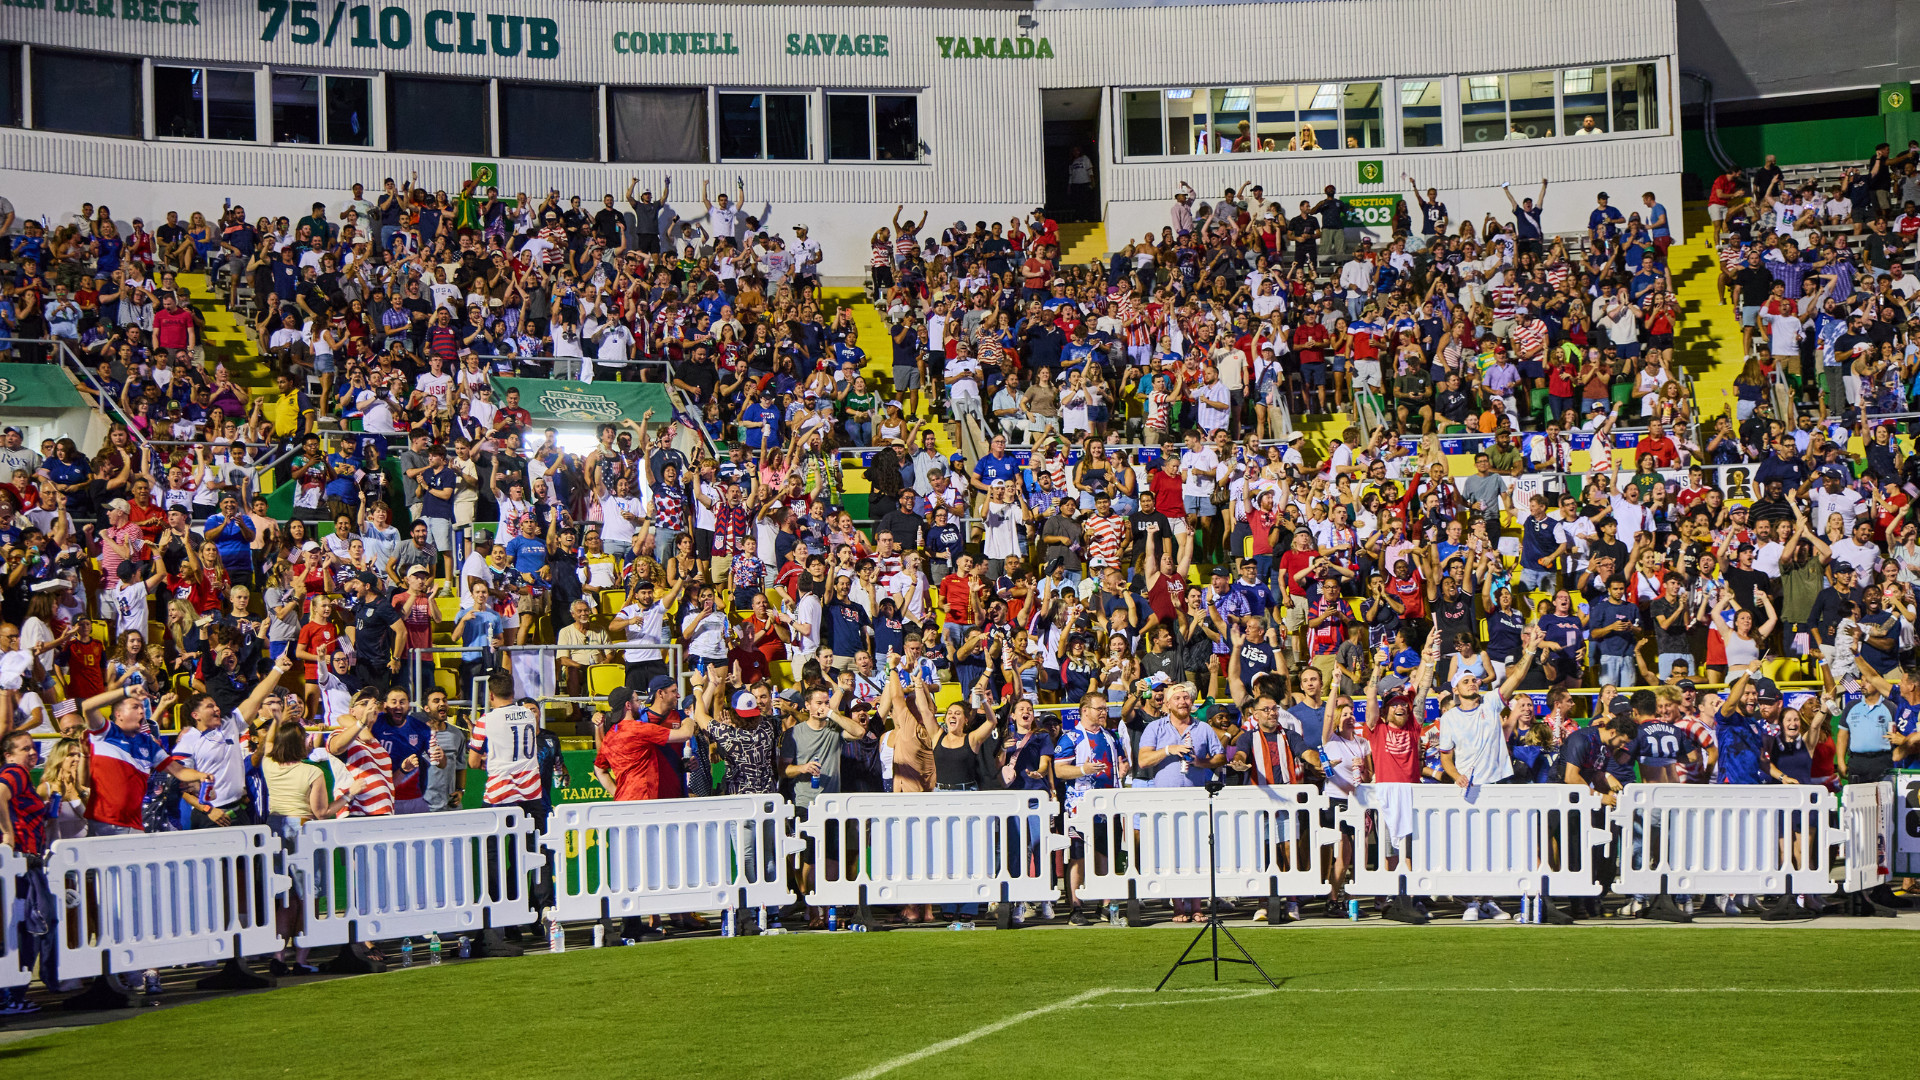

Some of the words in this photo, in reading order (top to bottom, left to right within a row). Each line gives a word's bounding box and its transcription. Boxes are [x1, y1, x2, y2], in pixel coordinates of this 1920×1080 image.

[121, 0, 200, 26] BECK
[258, 1, 411, 50] 75/10
[424, 10, 560, 60] CLUB
[613, 31, 739, 56] CONNELL
[786, 34, 889, 58] SAVAGE
[936, 36, 1054, 60] YAMADA
[1349, 198, 1393, 207] SECTION
[1354, 207, 1391, 223] 303
[430, 386, 446, 395] USA
[549, 392, 581, 400] TAMPA
[1, 452, 28, 468] RAYS
[988, 468, 996, 478] 10
[1517, 480, 1537, 491] USA
[1676, 474, 1690, 487] US
[940, 532, 958, 543] USA
[83, 654, 95, 666] 19
[505, 711, 528, 721] PULISIC
[1644, 723, 1675, 735] DONOVAN
[1896, 716, 1906, 731] 22
[511, 723, 536, 762] 10
[1647, 735, 1679, 758] 10
[562, 786, 613, 800] TAMPA
